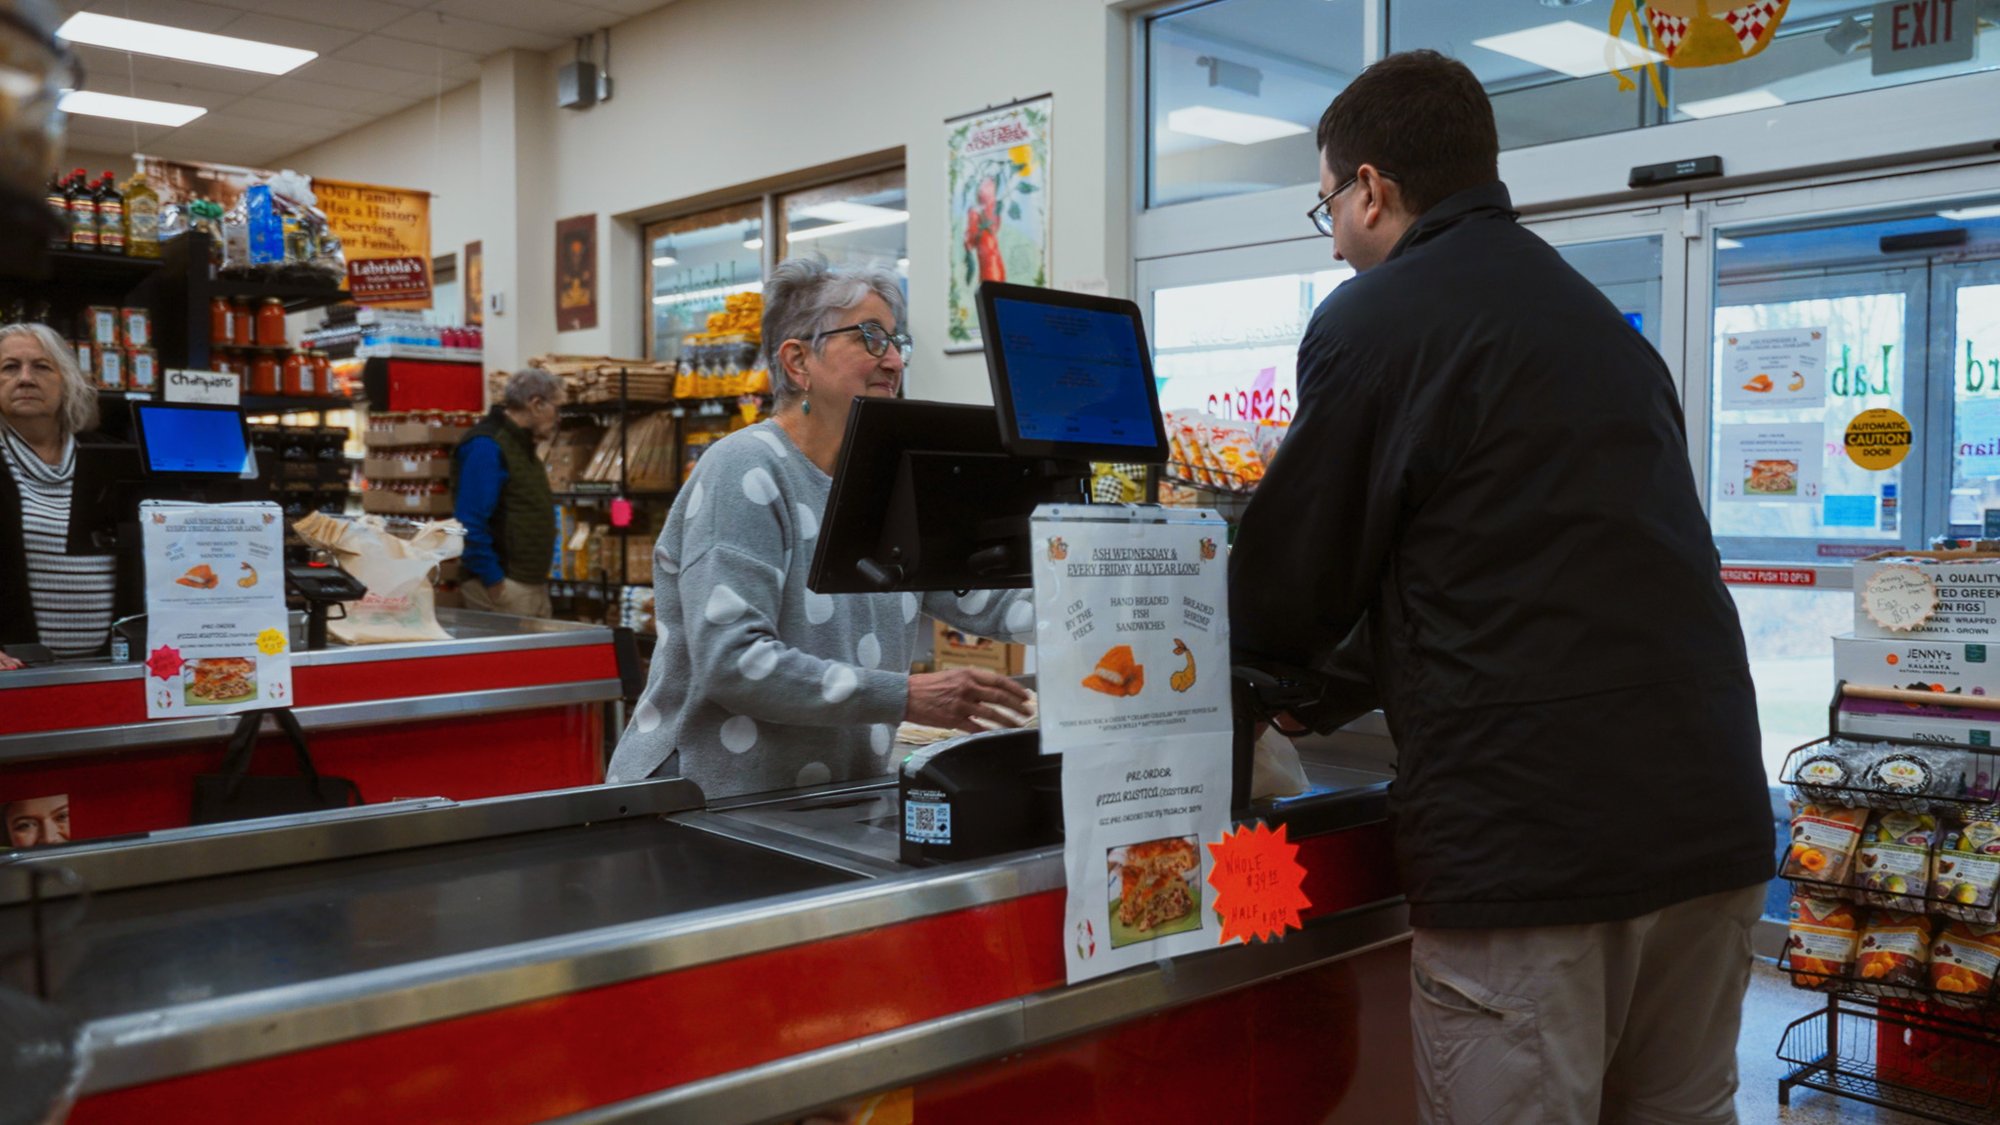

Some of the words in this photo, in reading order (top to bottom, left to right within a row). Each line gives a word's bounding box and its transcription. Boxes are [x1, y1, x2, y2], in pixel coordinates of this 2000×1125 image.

[1892, 0, 1956, 51] EXIT
[322, 186, 350, 199] Our
[357, 189, 403, 207] Family
[322, 200, 349, 213] Has
[367, 205, 418, 227] History
[342, 219, 394, 237] Serving
[352, 259, 421, 276] Labriola's
[1852, 421, 1905, 430] AUTOMATIC
[1847, 433, 1908, 446] CAUTION
[1092, 548, 1112, 560] ASH
[1114, 548, 1169, 560] WEDNESDAY
[1171, 548, 1178, 560] &
[1067, 563, 1098, 577] EVERY
[1100, 563, 1133, 576] FRIDAY
[1134, 563, 1152, 576] ALL
[1153, 562, 1178, 576] YEAR
[1178, 562, 1200, 576] LONG
[1758, 571, 1777, 582] PUSH
[1779, 572, 1789, 582] TO
[1791, 572, 1810, 583] OPEN
[1935, 573, 1944, 583] A
[1067, 600, 1084, 616] COD
[1110, 597, 1134, 607] HAND
[1135, 596, 1169, 607] BREADED
[1183, 596, 1215, 616] BREADED
[1956, 602, 1982, 612] FIGS
[1076, 607, 1094, 626] THE
[1132, 609, 1150, 619] FISH
[1183, 609, 1211, 627] SHRIMP
[1955, 617, 1997, 625] WRAPPED
[1071, 622, 1096, 641] PIECE
[1115, 621, 1166, 632] SANDWICHES
[1956, 627, 1989, 635] GROWN
[1908, 663, 1951, 671] KALAMATA
[1126, 768, 1171, 783] PRE-ORDER
[1225, 851, 1263, 875] WHOLE
[1231, 904, 1257, 922] HALF
